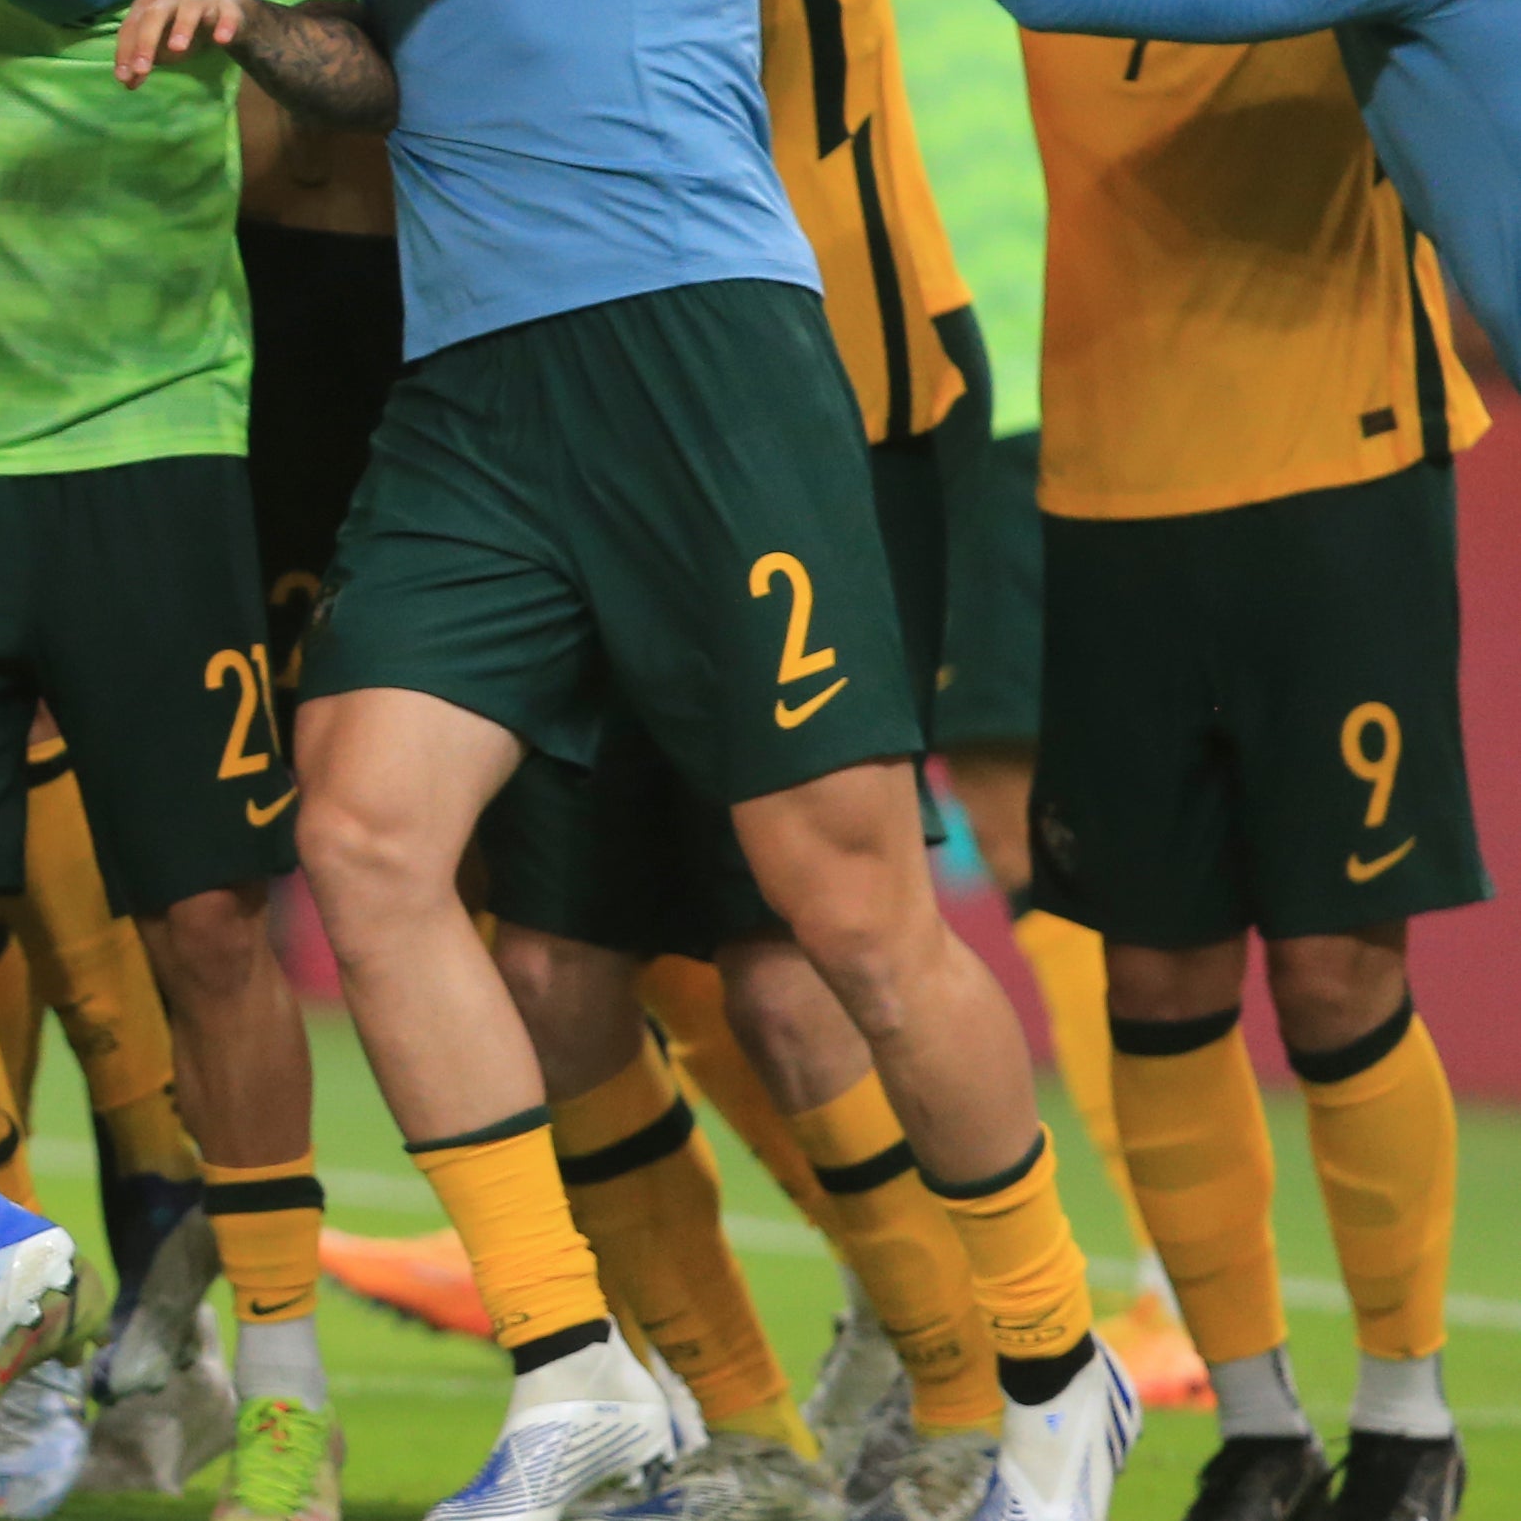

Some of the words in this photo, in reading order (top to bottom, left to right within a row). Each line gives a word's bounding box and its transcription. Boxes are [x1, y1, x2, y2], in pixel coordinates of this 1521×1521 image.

[748, 551, 836, 685] 2
[204, 643, 282, 780] 21
[1341, 700, 1402, 828] 9
